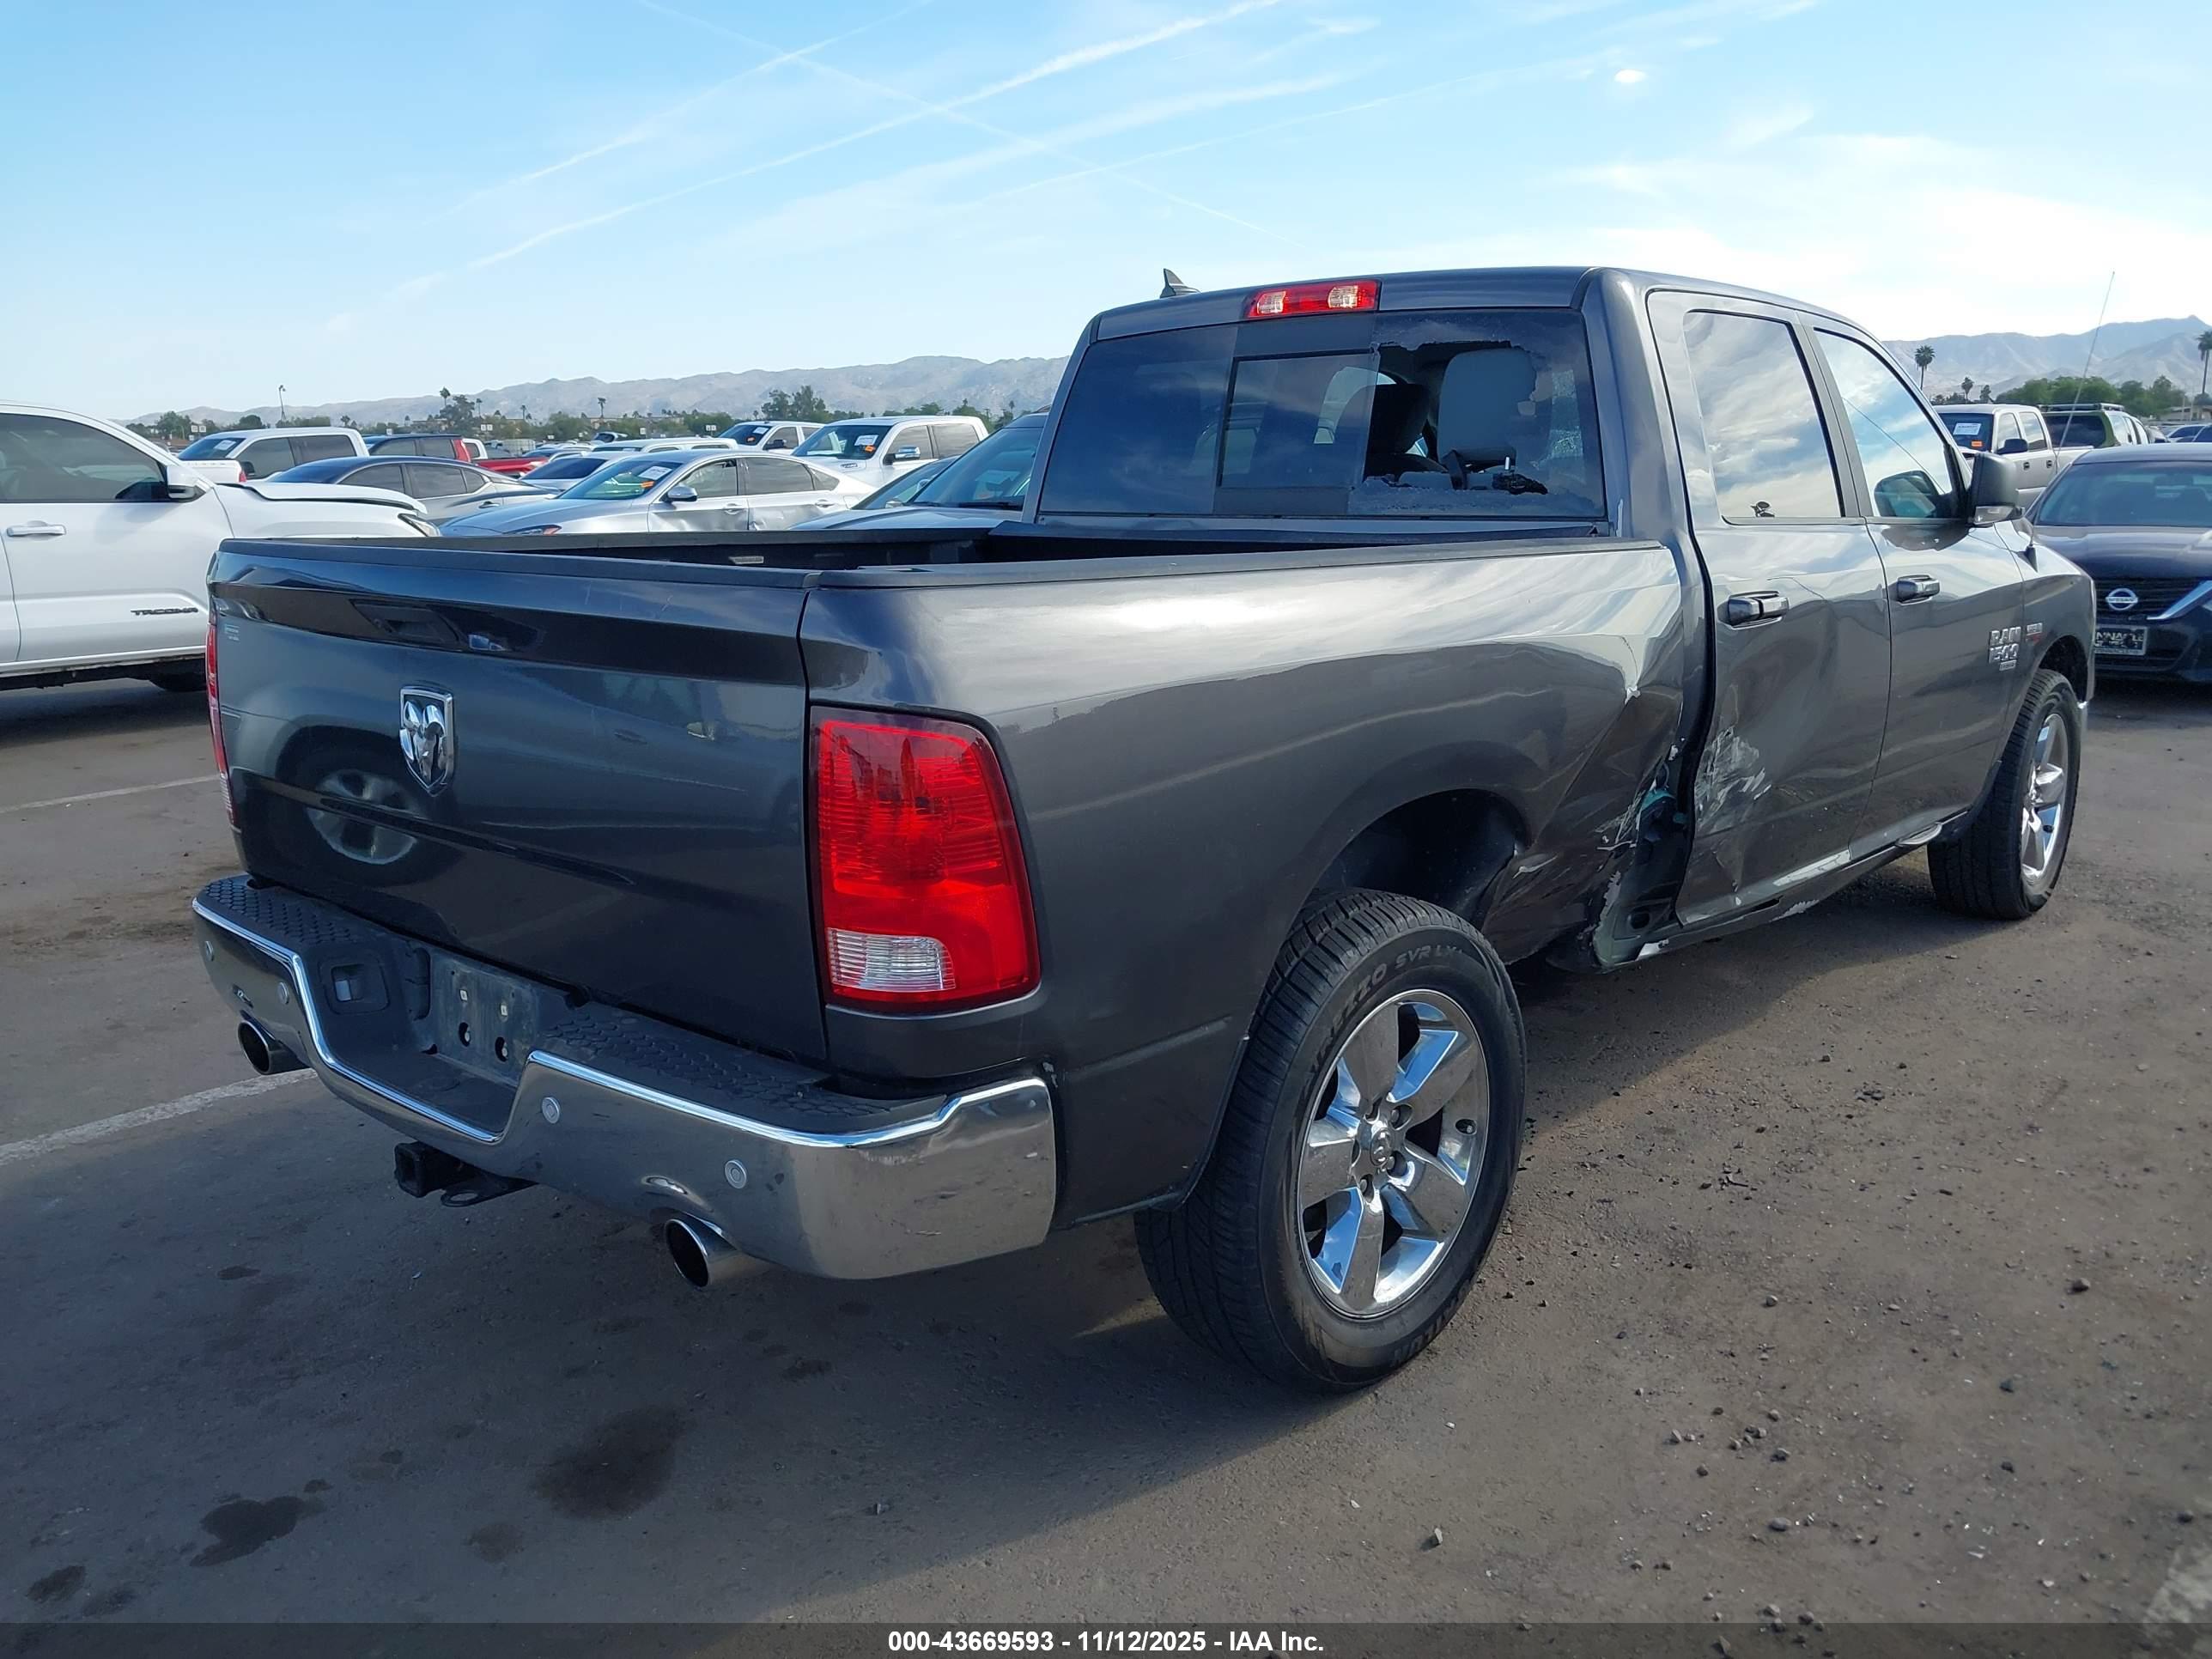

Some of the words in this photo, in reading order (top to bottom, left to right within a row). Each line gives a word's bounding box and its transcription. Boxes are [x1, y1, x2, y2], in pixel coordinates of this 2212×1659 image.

[130, 607, 198, 616] TACOMA
[1990, 627, 2021, 646] RAM
[1988, 643, 2019, 664] 1500
[1395, 945, 1431, 969] SVR
